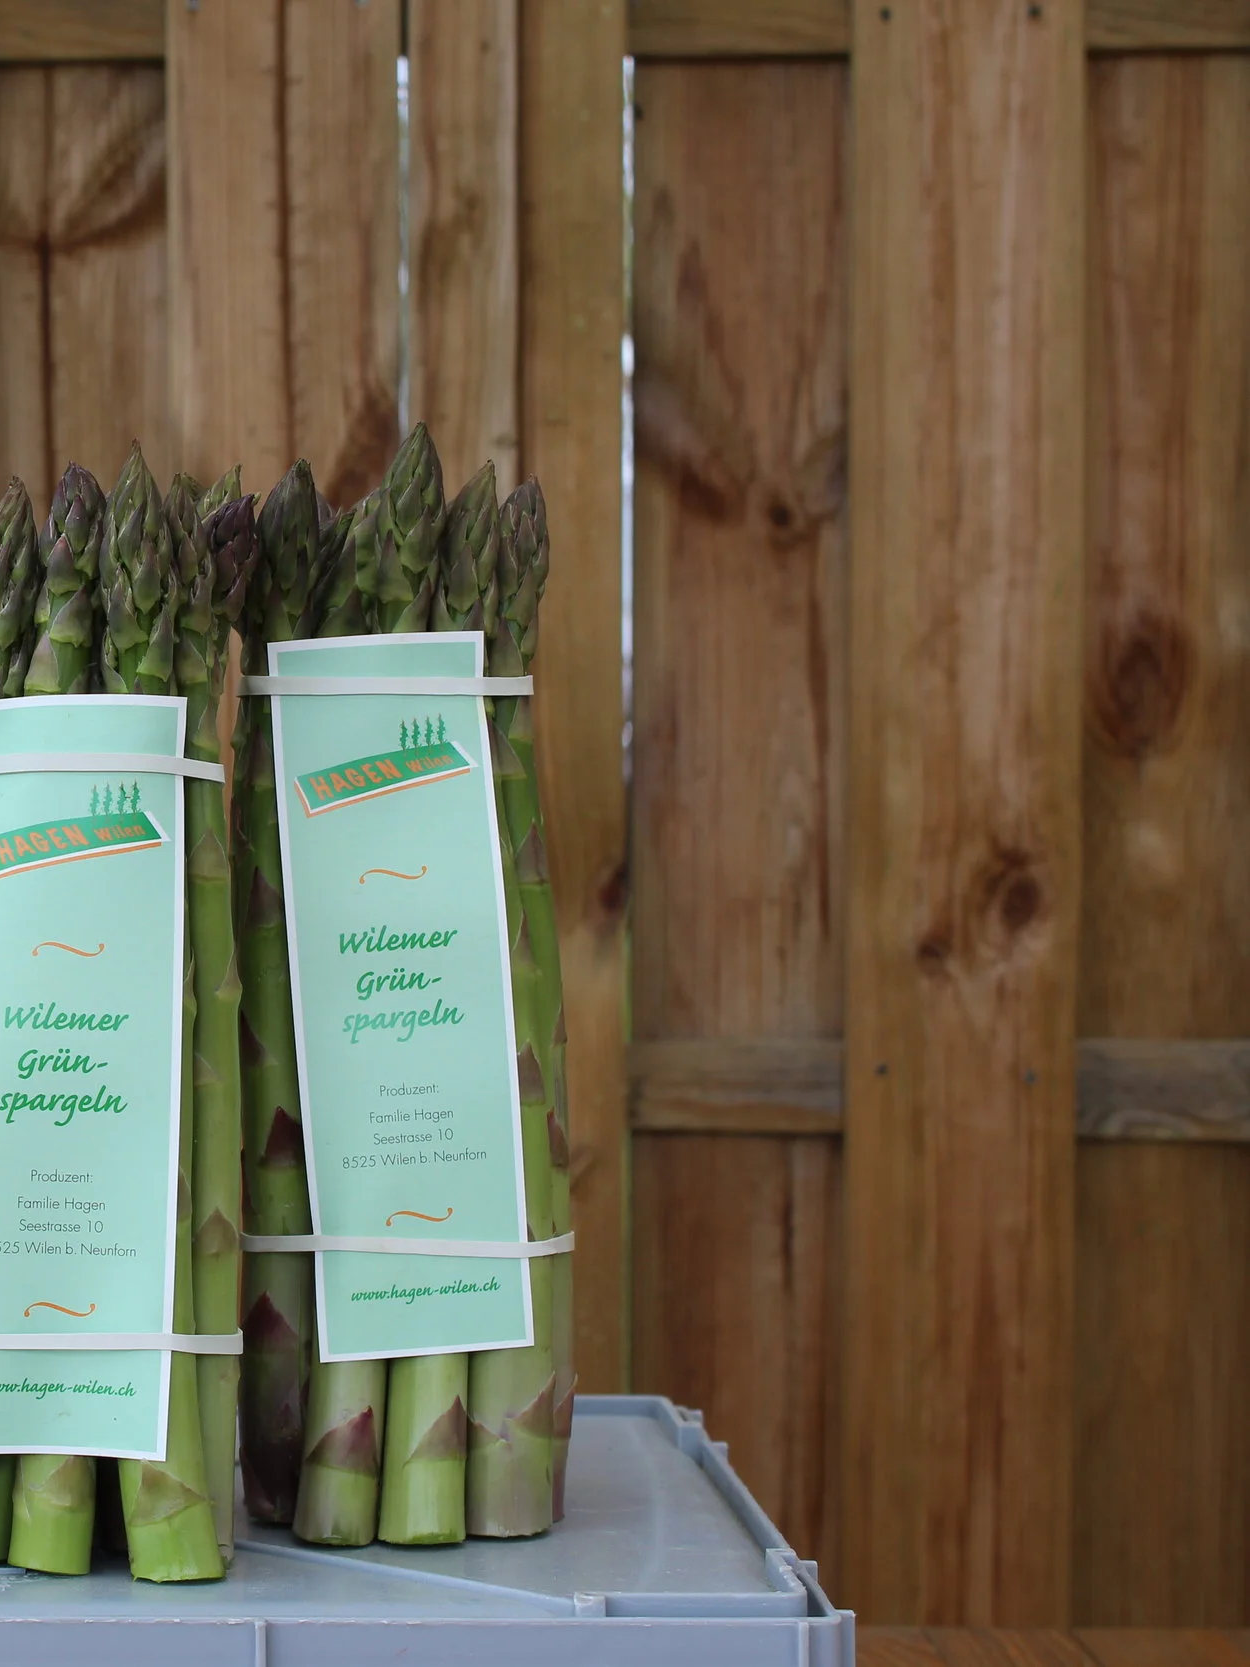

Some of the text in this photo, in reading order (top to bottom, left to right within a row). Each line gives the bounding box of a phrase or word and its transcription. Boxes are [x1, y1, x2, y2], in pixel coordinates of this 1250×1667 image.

[308, 754, 454, 802] HAGEN Wilen
[93, 824, 146, 842] Wilen
[338, 925, 458, 954] Wilemer
[356, 968, 443, 1001] Grün-
[4, 1001, 129, 1032] Wilemer
[342, 999, 464, 1044] spargeln
[17, 1048, 108, 1080] Grün-
[379, 1082, 440, 1097] Produzent:
[369, 1108, 454, 1124] Familie Hagen
[373, 1128, 454, 1146] Seestrasse 10
[342, 1147, 487, 1169] 8525 Wilen b. Neunforn
[30, 1169, 94, 1184] Produzent:
[17, 1196, 106, 1214] Familie Hagen
[19, 1219, 104, 1233] Seestrasse 10
[24, 1241, 62, 1255] Wilen
[65, 1242, 77, 1255] b.
[80, 1242, 136, 1257] Neunforn
[350, 1276, 501, 1305] www.hagen-wilen.ch
